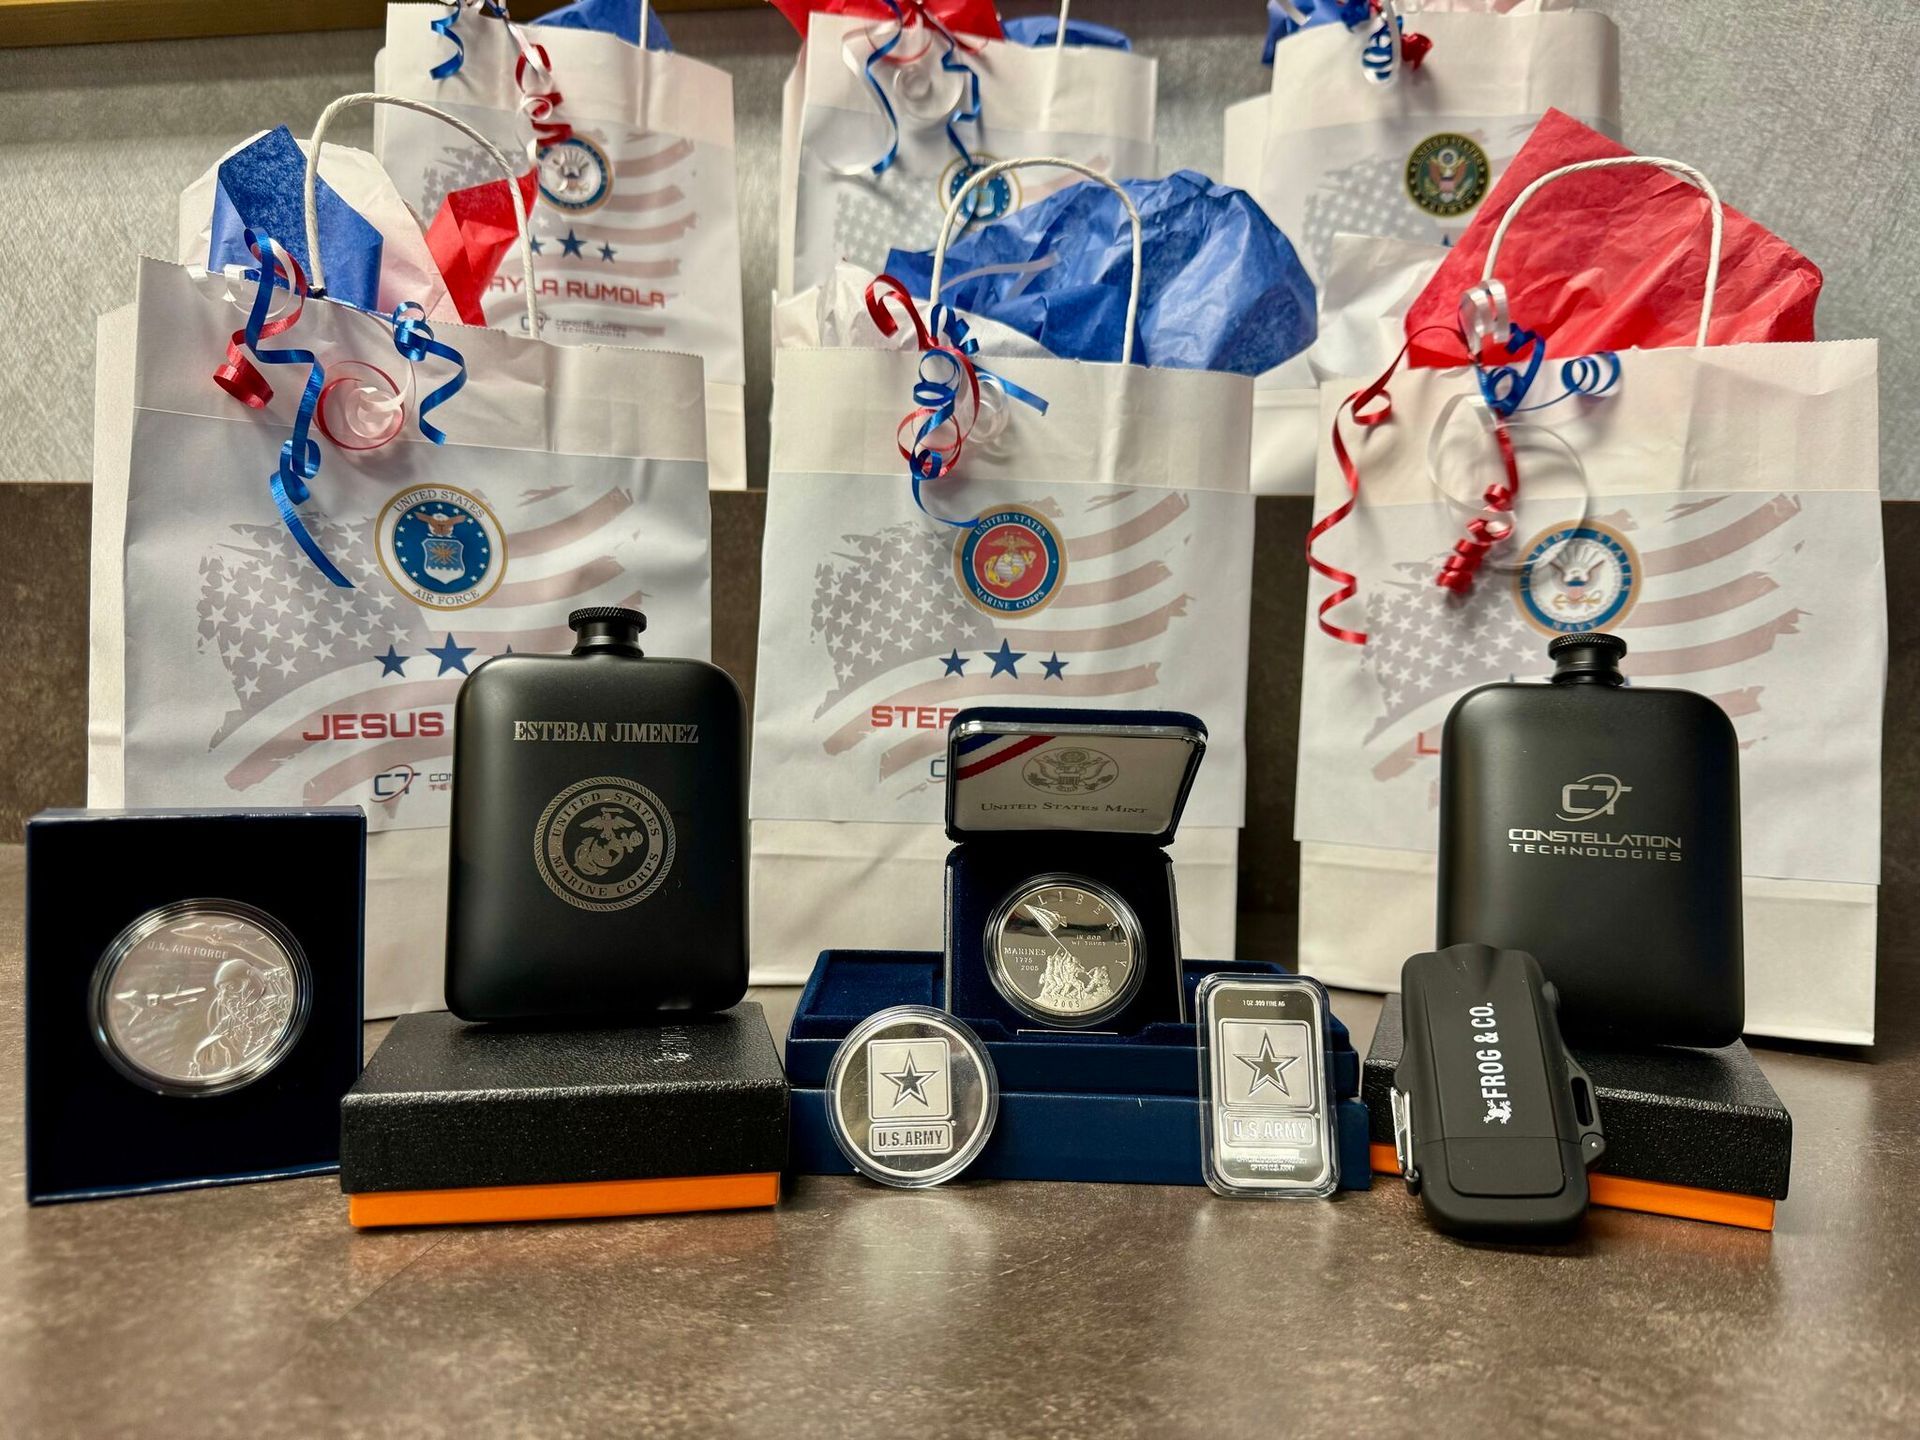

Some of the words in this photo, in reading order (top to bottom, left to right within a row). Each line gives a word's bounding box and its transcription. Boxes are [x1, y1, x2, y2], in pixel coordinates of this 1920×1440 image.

[566, 280, 666, 308] RUMOLA
[393, 489, 437, 513] UNITED
[440, 490, 485, 519] STATES
[974, 514, 1010, 536] UNITED
[1014, 514, 1048, 537] STATES
[413, 589, 434, 603] AIR
[437, 589, 480, 606] FORCE
[974, 583, 1010, 610] MARINE
[1016, 590, 1045, 609] CORPS
[302, 711, 445, 741] JESUS
[513, 720, 608, 743] ESTEBAN
[610, 722, 699, 744] JIMENEZ
[551, 791, 601, 838] UNITED
[613, 791, 661, 838] STATES
[1507, 827, 1682, 849] CONSTELLATION
[1507, 843, 1683, 862] TECHNOLOGIES
[550, 854, 609, 897] MARINE
[615, 852, 660, 895] CORPS
[1037, 890, 1128, 968] LIBERTY
[172, 944, 191, 955] AIR
[193, 946, 229, 960] FORCE
[1003, 946, 1047, 956] MARINES
[1053, 1000, 1081, 1008] 2005
[1469, 1002, 1497, 1029] CO.
[1473, 1031, 1500, 1044] &
[1475, 1049, 1509, 1099] FROG
